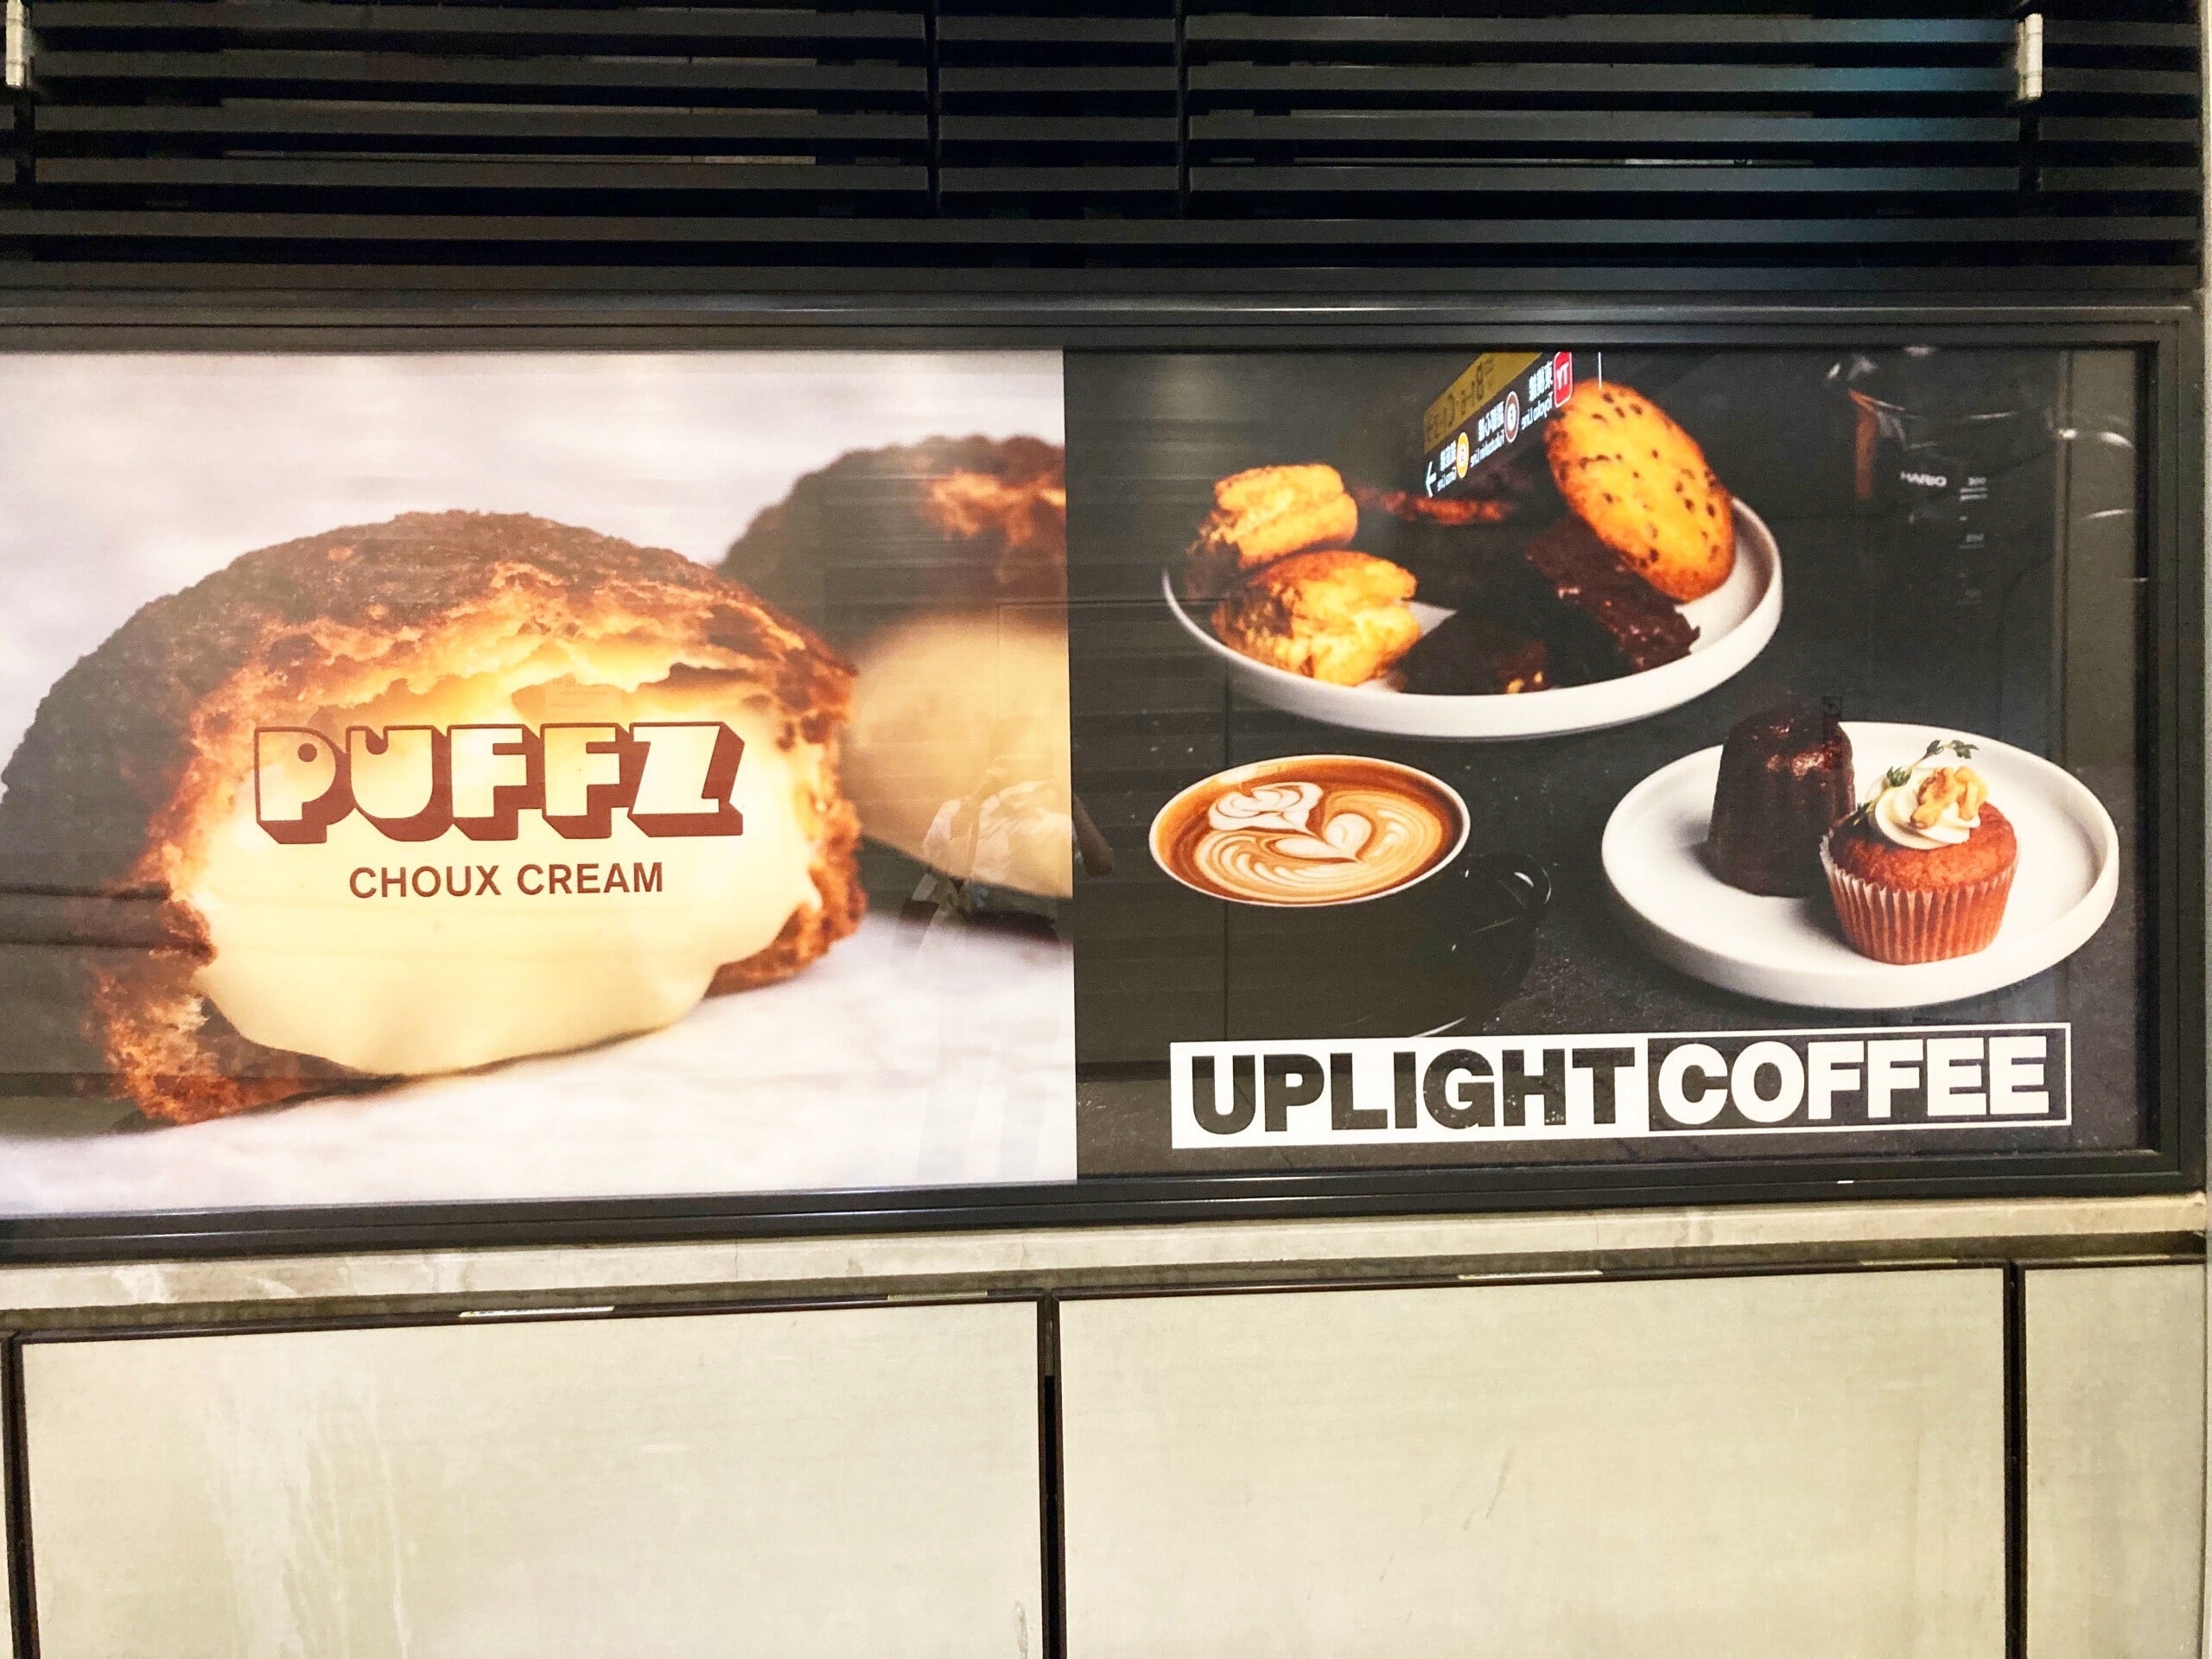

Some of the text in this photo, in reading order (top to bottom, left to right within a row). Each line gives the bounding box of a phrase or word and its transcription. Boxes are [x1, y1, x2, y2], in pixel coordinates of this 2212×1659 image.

[254, 721, 746, 844] PUFFZ
[348, 861, 664, 899] CHOUX CREAM
[1191, 1035, 2050, 1135] UPLIGHT COFFEE
